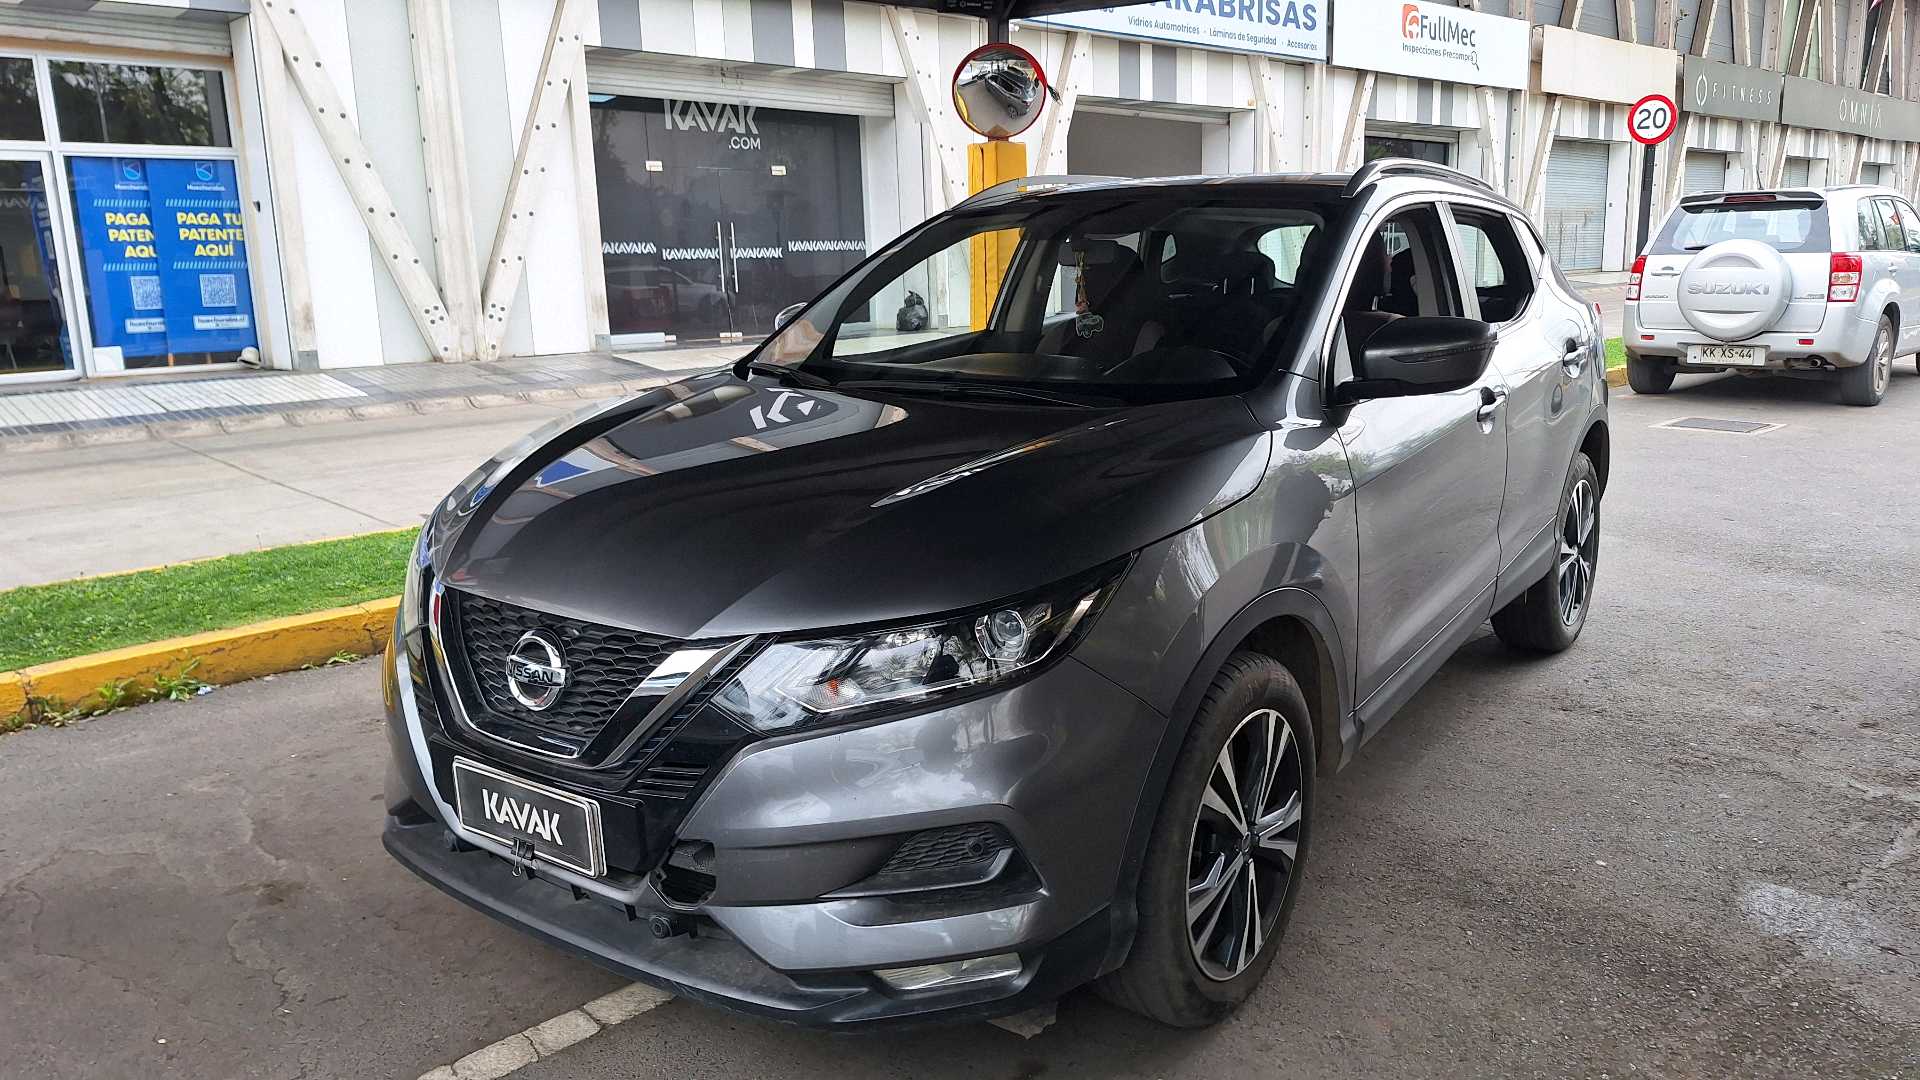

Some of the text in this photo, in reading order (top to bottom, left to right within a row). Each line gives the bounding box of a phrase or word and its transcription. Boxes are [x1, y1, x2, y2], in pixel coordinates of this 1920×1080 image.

[1128, 16, 1200, 35] Vidrios Automotrices
[1420, 15, 1476, 47] FullMec
[1238, 32, 1246, 41] de
[1246, 33, 1277, 46] Seguridad
[1287, 40, 1318, 51] Accesorios
[1402, 42, 1442, 57] Inspecciones
[1713, 82, 1772, 105] FITNESS
[664, 99, 759, 134] KAVAK
[1637, 107, 1667, 130] 20
[728, 136, 761, 150] .COM
[105, 212, 149, 226] PAGA
[176, 212, 243, 226] PAGA TU
[179, 228, 243, 241] PATENTE
[194, 243, 234, 257] AQUÍ
[1687, 280, 1769, 295] SUZUKI
[482, 788, 564, 846] KAVAK
